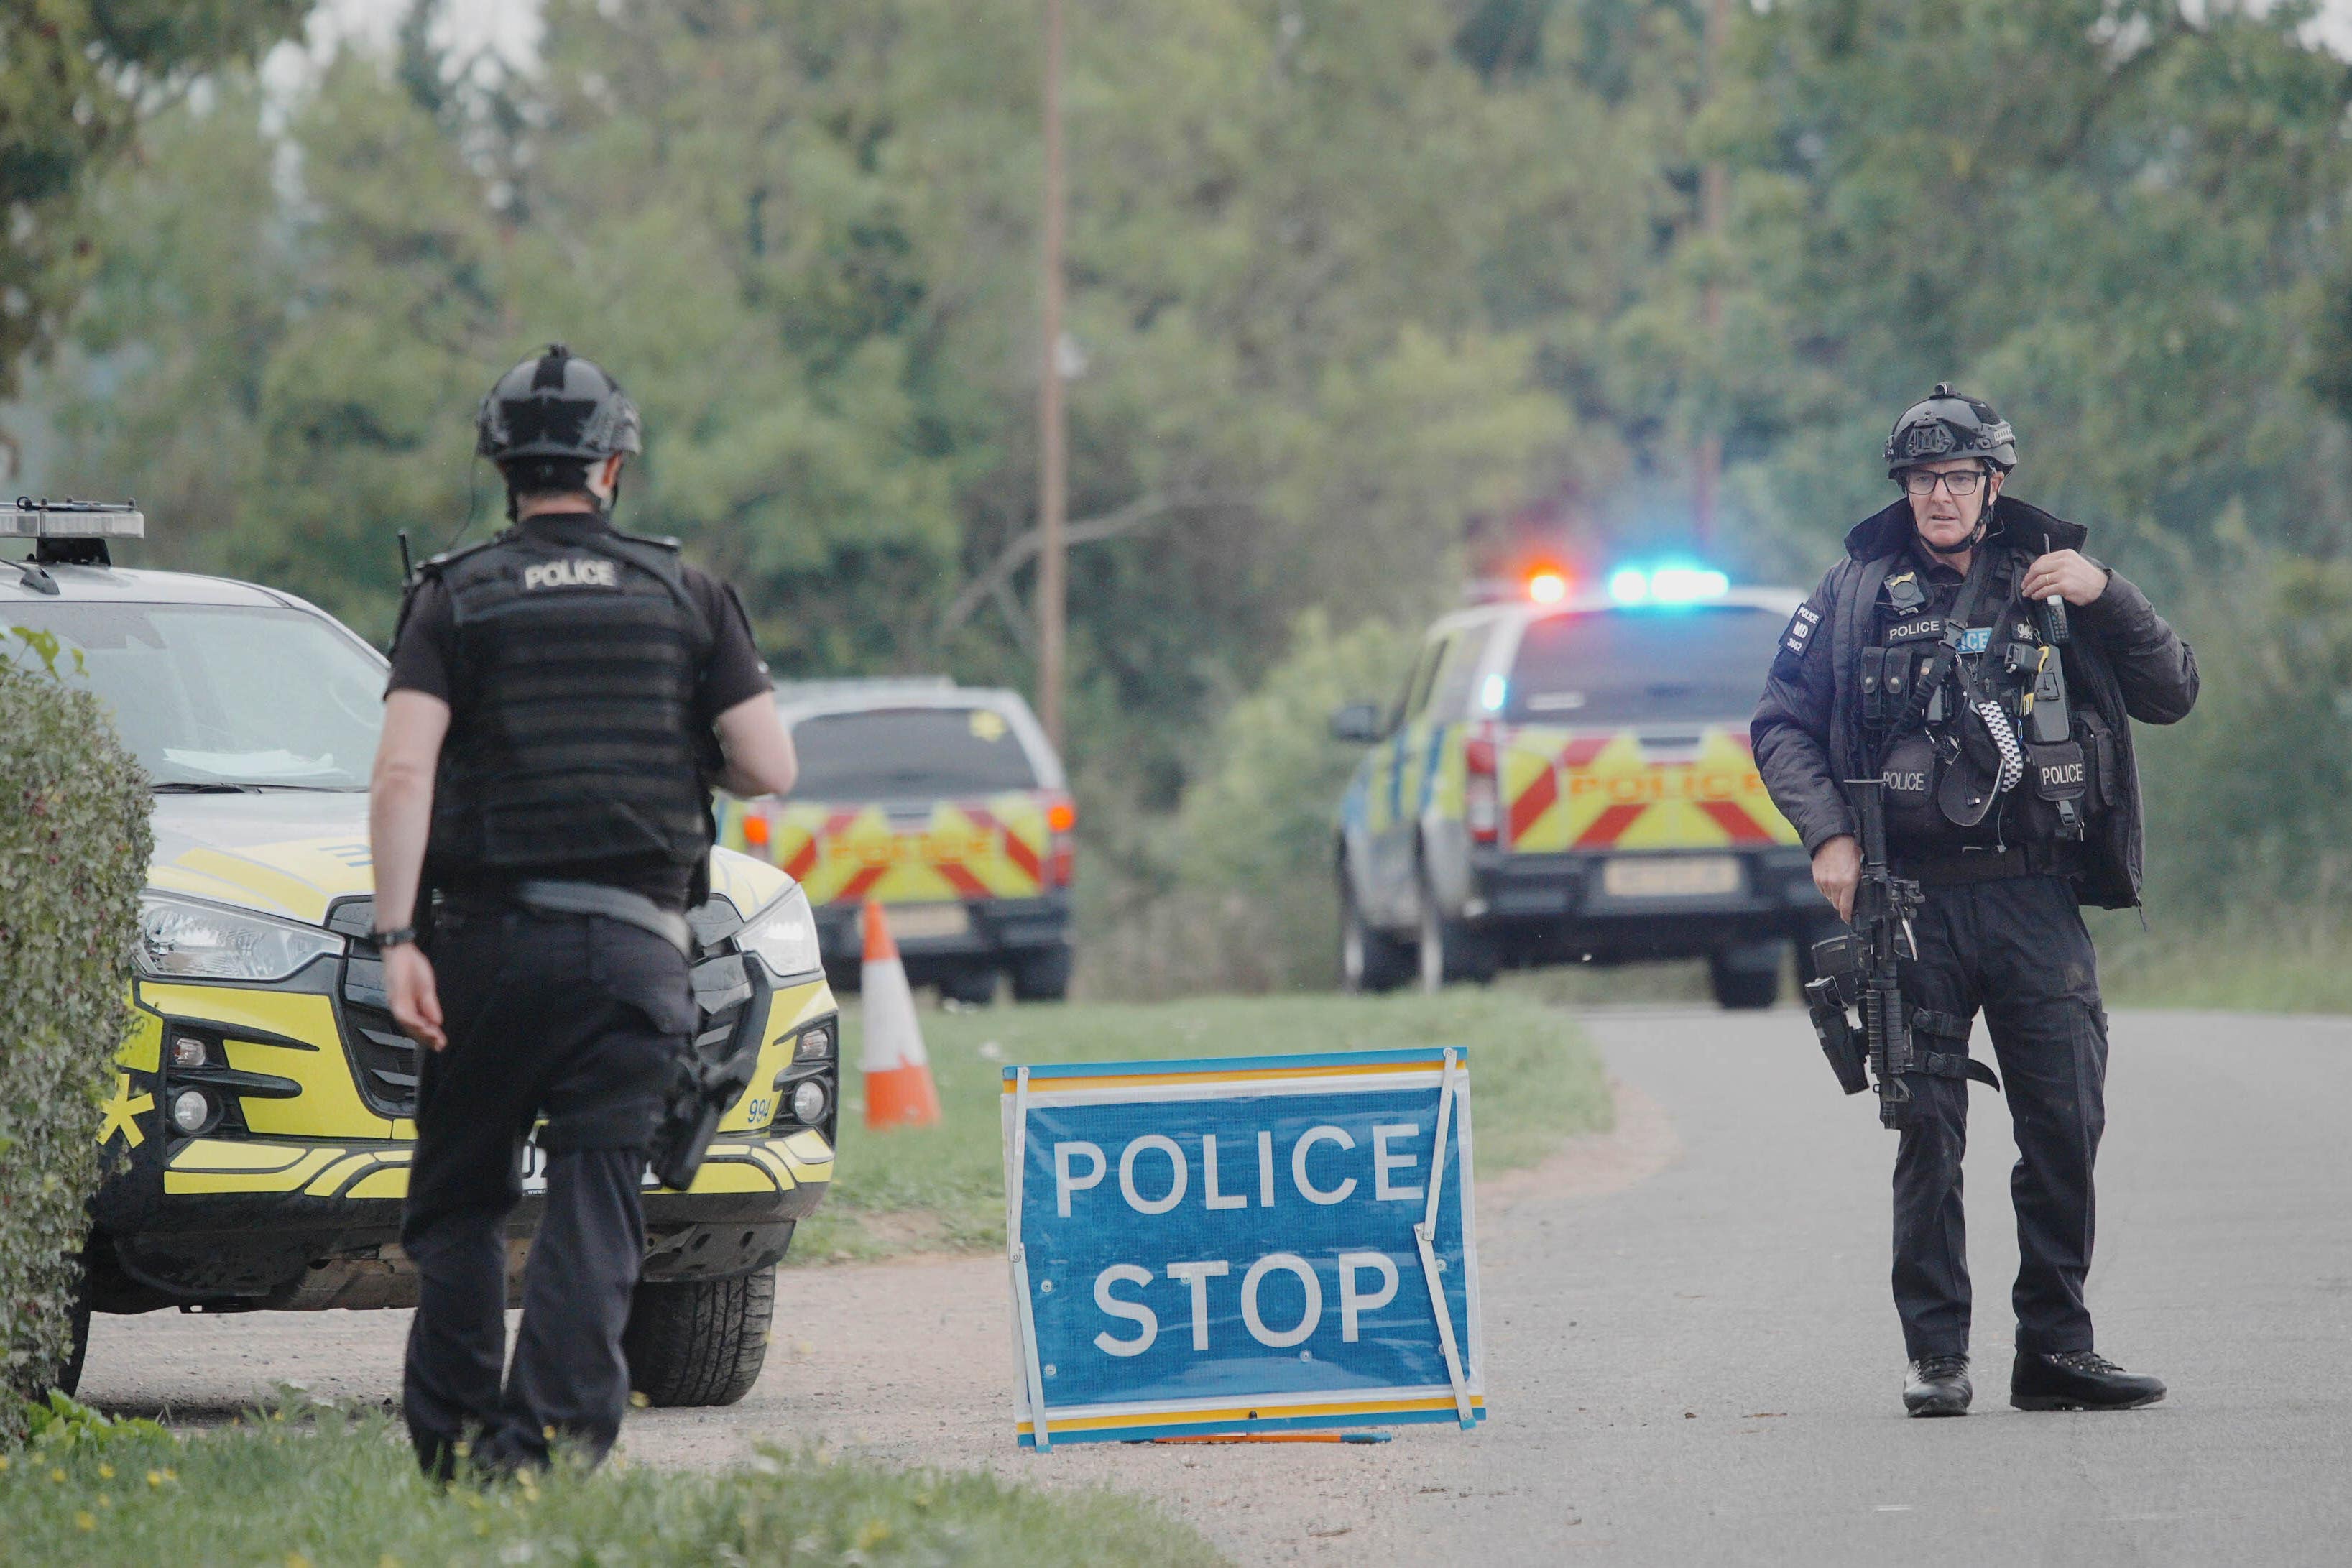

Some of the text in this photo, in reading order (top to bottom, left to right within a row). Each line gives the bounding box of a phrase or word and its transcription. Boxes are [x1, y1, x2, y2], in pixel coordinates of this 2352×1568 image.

[524, 558, 615, 590] POLICE
[1798, 606, 1820, 624] POLICE
[1792, 621, 1809, 639] MD
[1888, 620, 1940, 640] POLICE
[1882, 771, 1924, 791] POLICE
[2041, 763, 2084, 785] POLICE
[1053, 1122, 1424, 1218] POLICE
[1092, 1252, 1400, 1357] STOP
